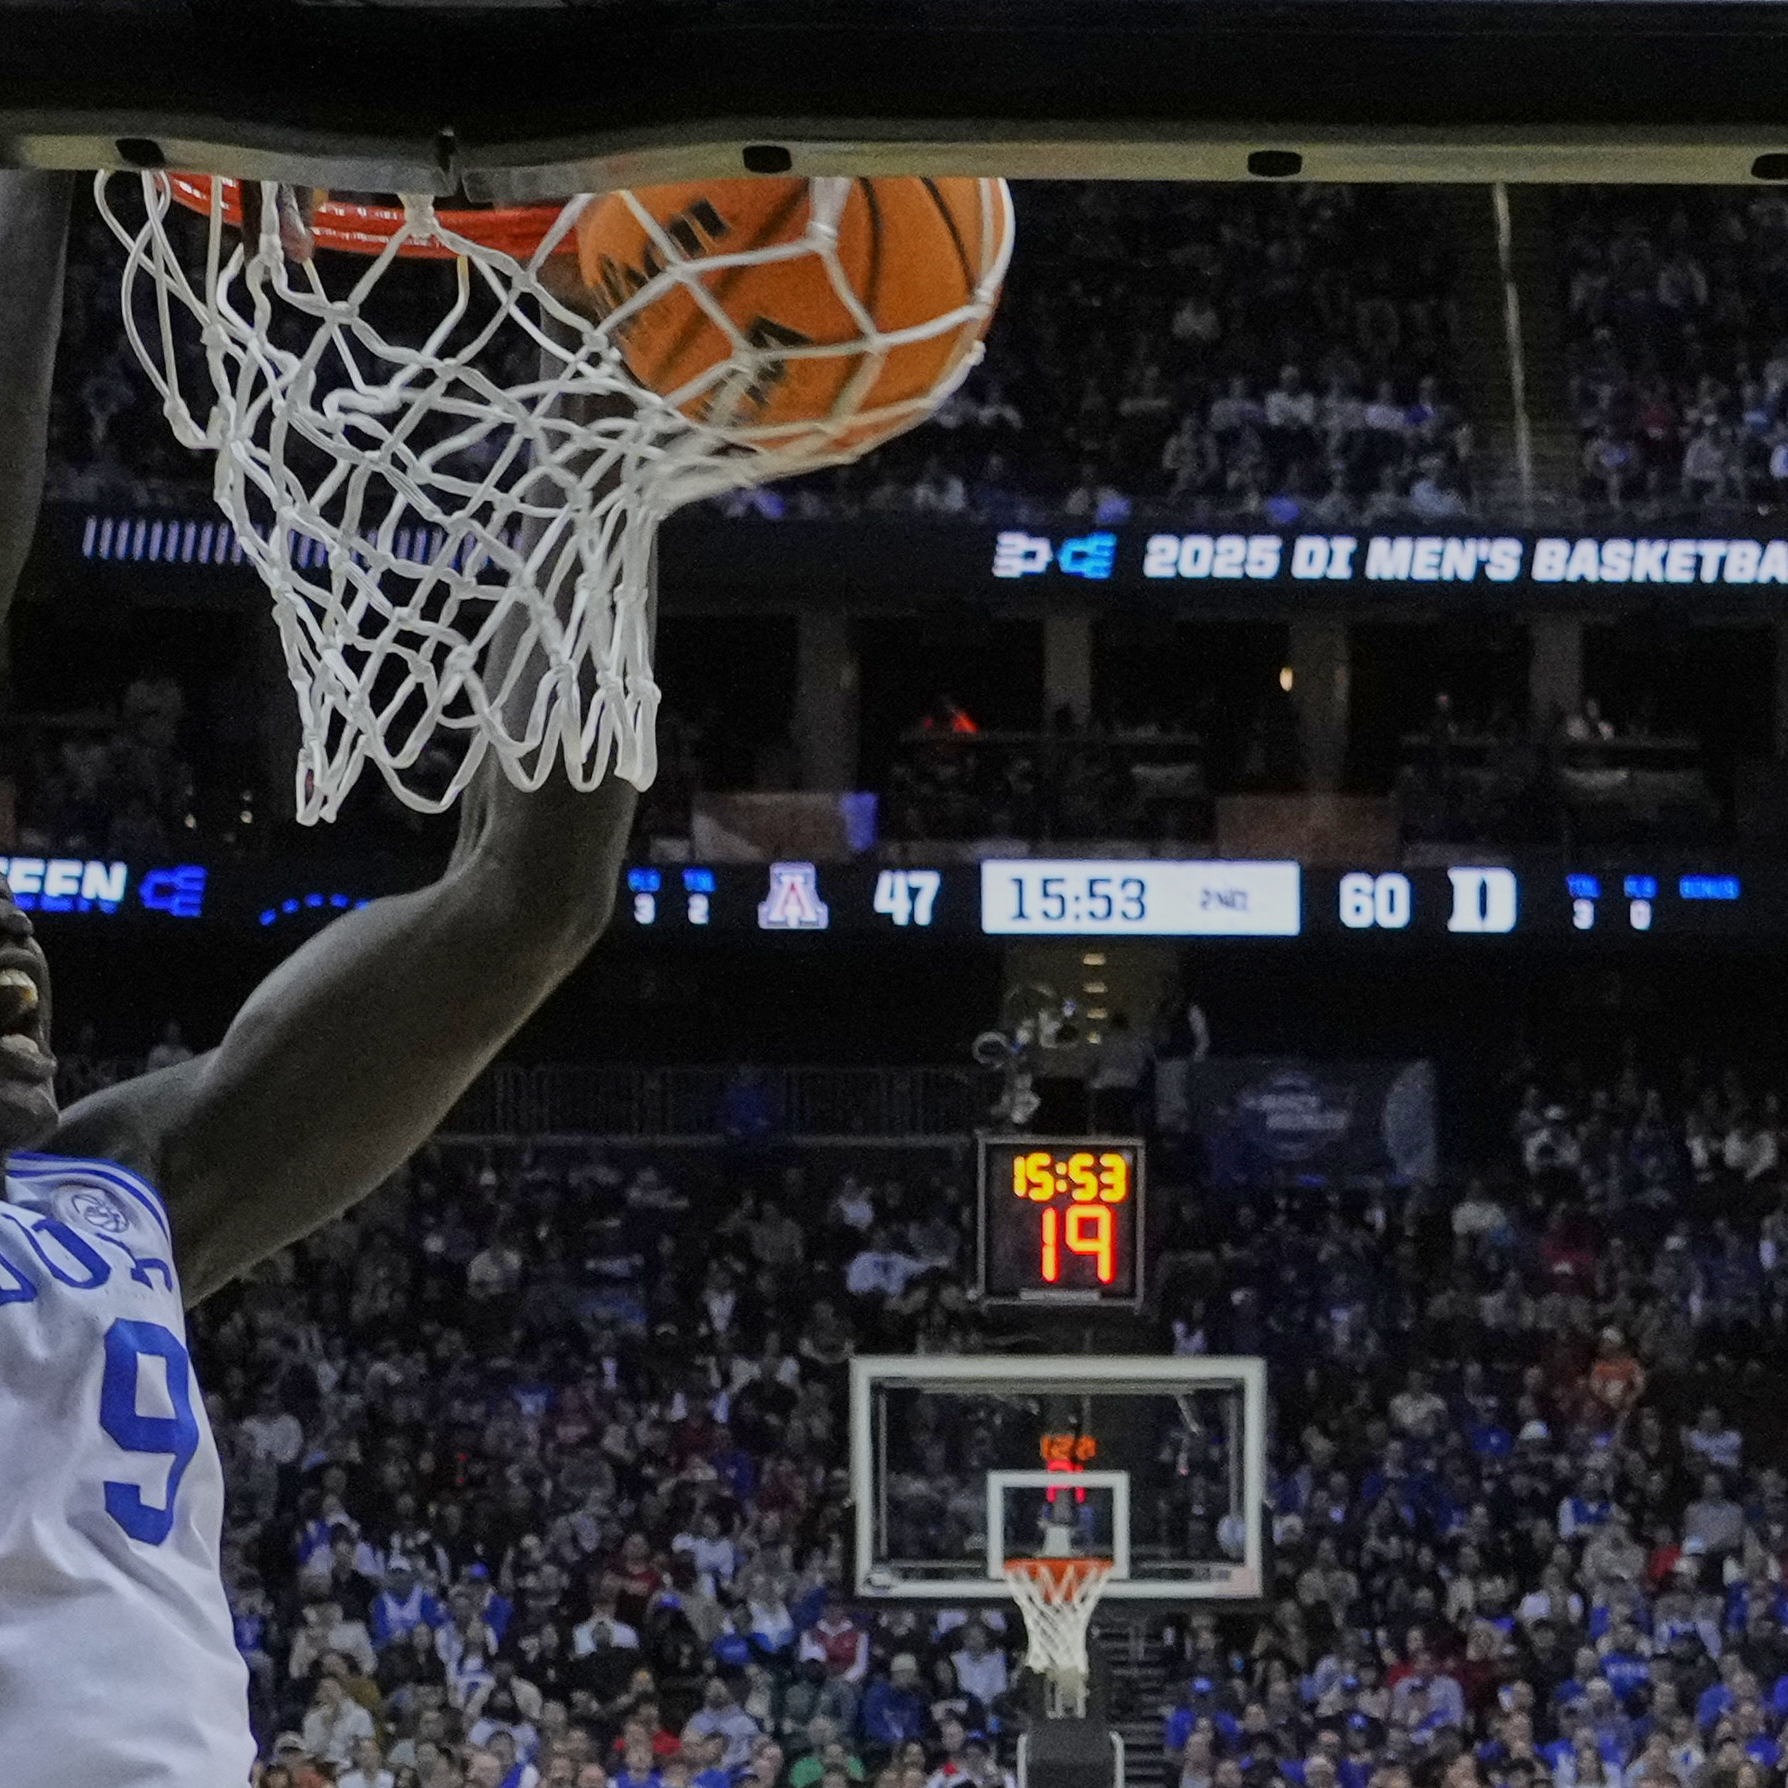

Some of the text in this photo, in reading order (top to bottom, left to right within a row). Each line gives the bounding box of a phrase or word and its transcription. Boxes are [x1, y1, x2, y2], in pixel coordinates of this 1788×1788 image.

[1143, 534, 1282, 579] 2025
[1291, 534, 1357, 580] DI
[1365, 535, 1522, 582] MEN'S
[873, 869, 941, 926] 47
[1011, 877, 1146, 921] 15:53
[1339, 871, 1411, 929] 60
[1013, 1152, 1127, 1202] 15:53
[1041, 1203, 1114, 1284] 19
[100, 1317, 199, 1546] 9
